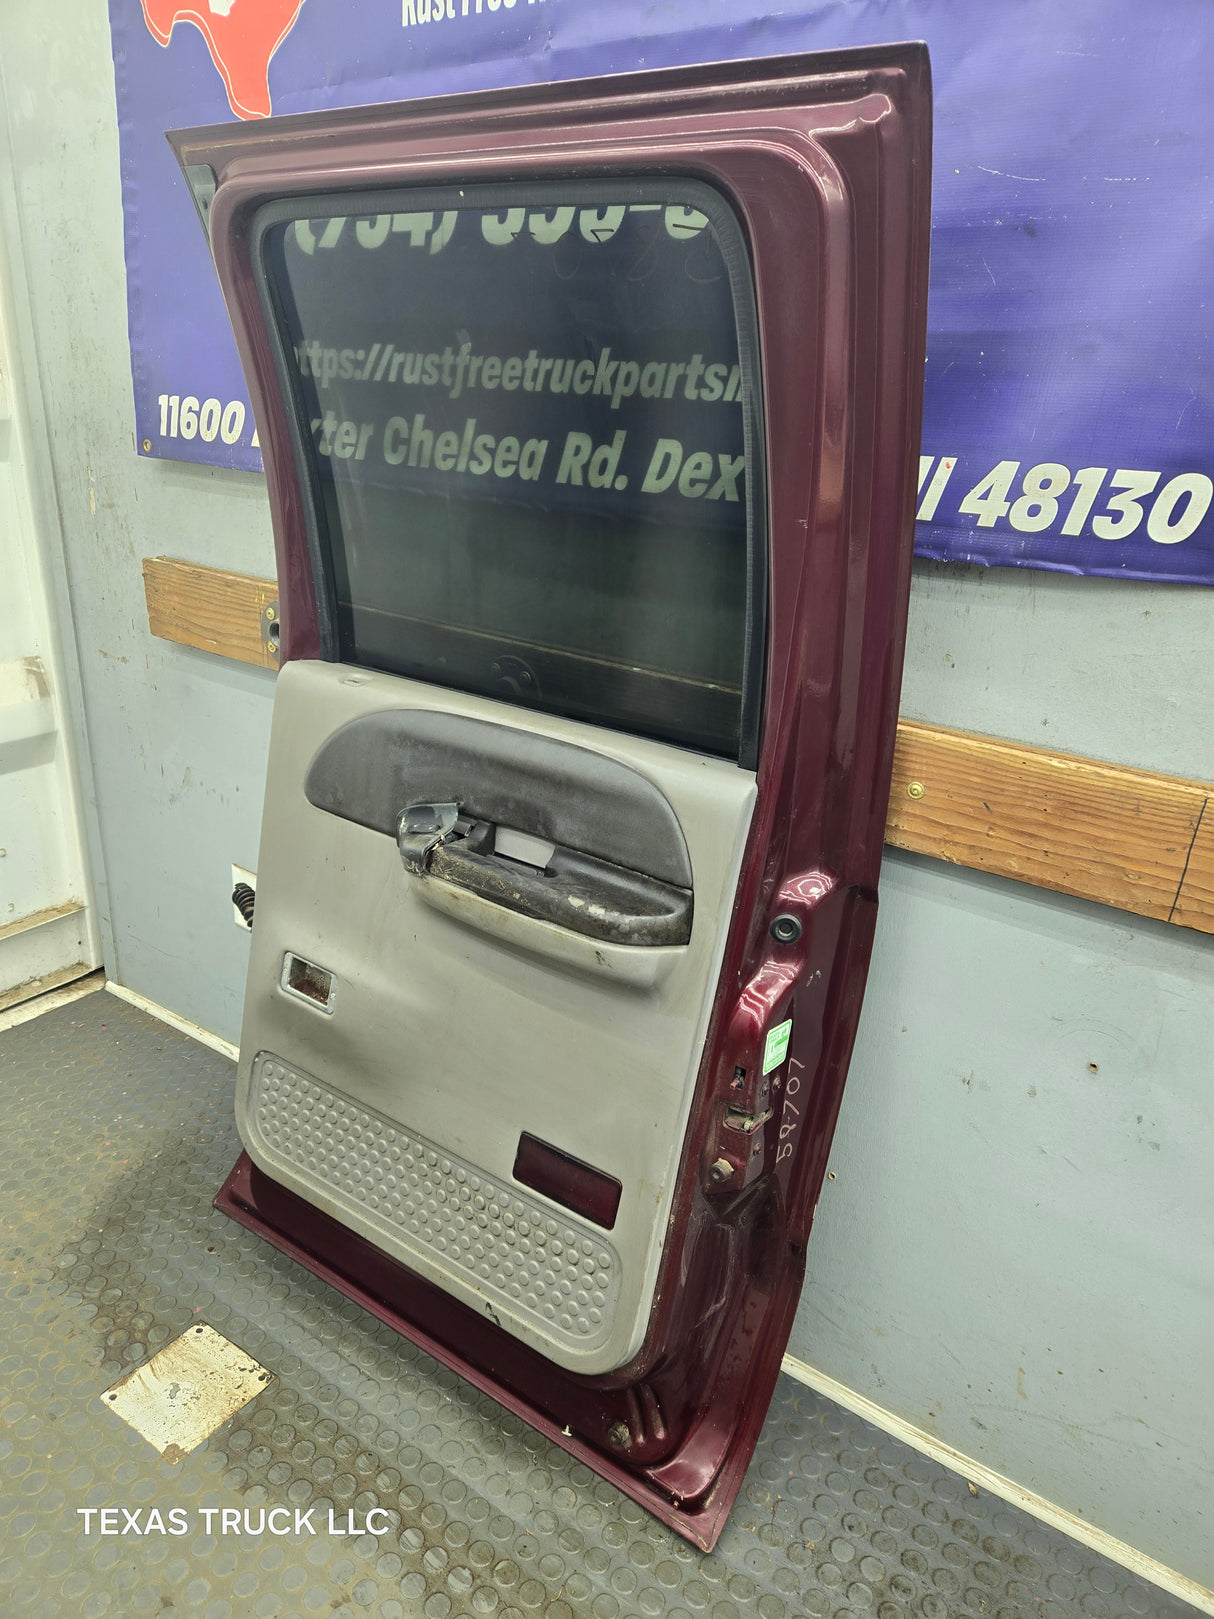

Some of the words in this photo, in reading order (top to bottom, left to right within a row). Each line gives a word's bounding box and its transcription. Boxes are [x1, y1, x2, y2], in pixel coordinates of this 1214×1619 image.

[294, 338, 742, 409] ttps://rustfreetruckparts
[158, 394, 246, 445] 11600
[311, 410, 374, 461] ter
[384, 413, 549, 482] Chelsea
[555, 429, 629, 491] Rd.
[641, 437, 746, 502] Dex
[958, 460, 1214, 544] 48130
